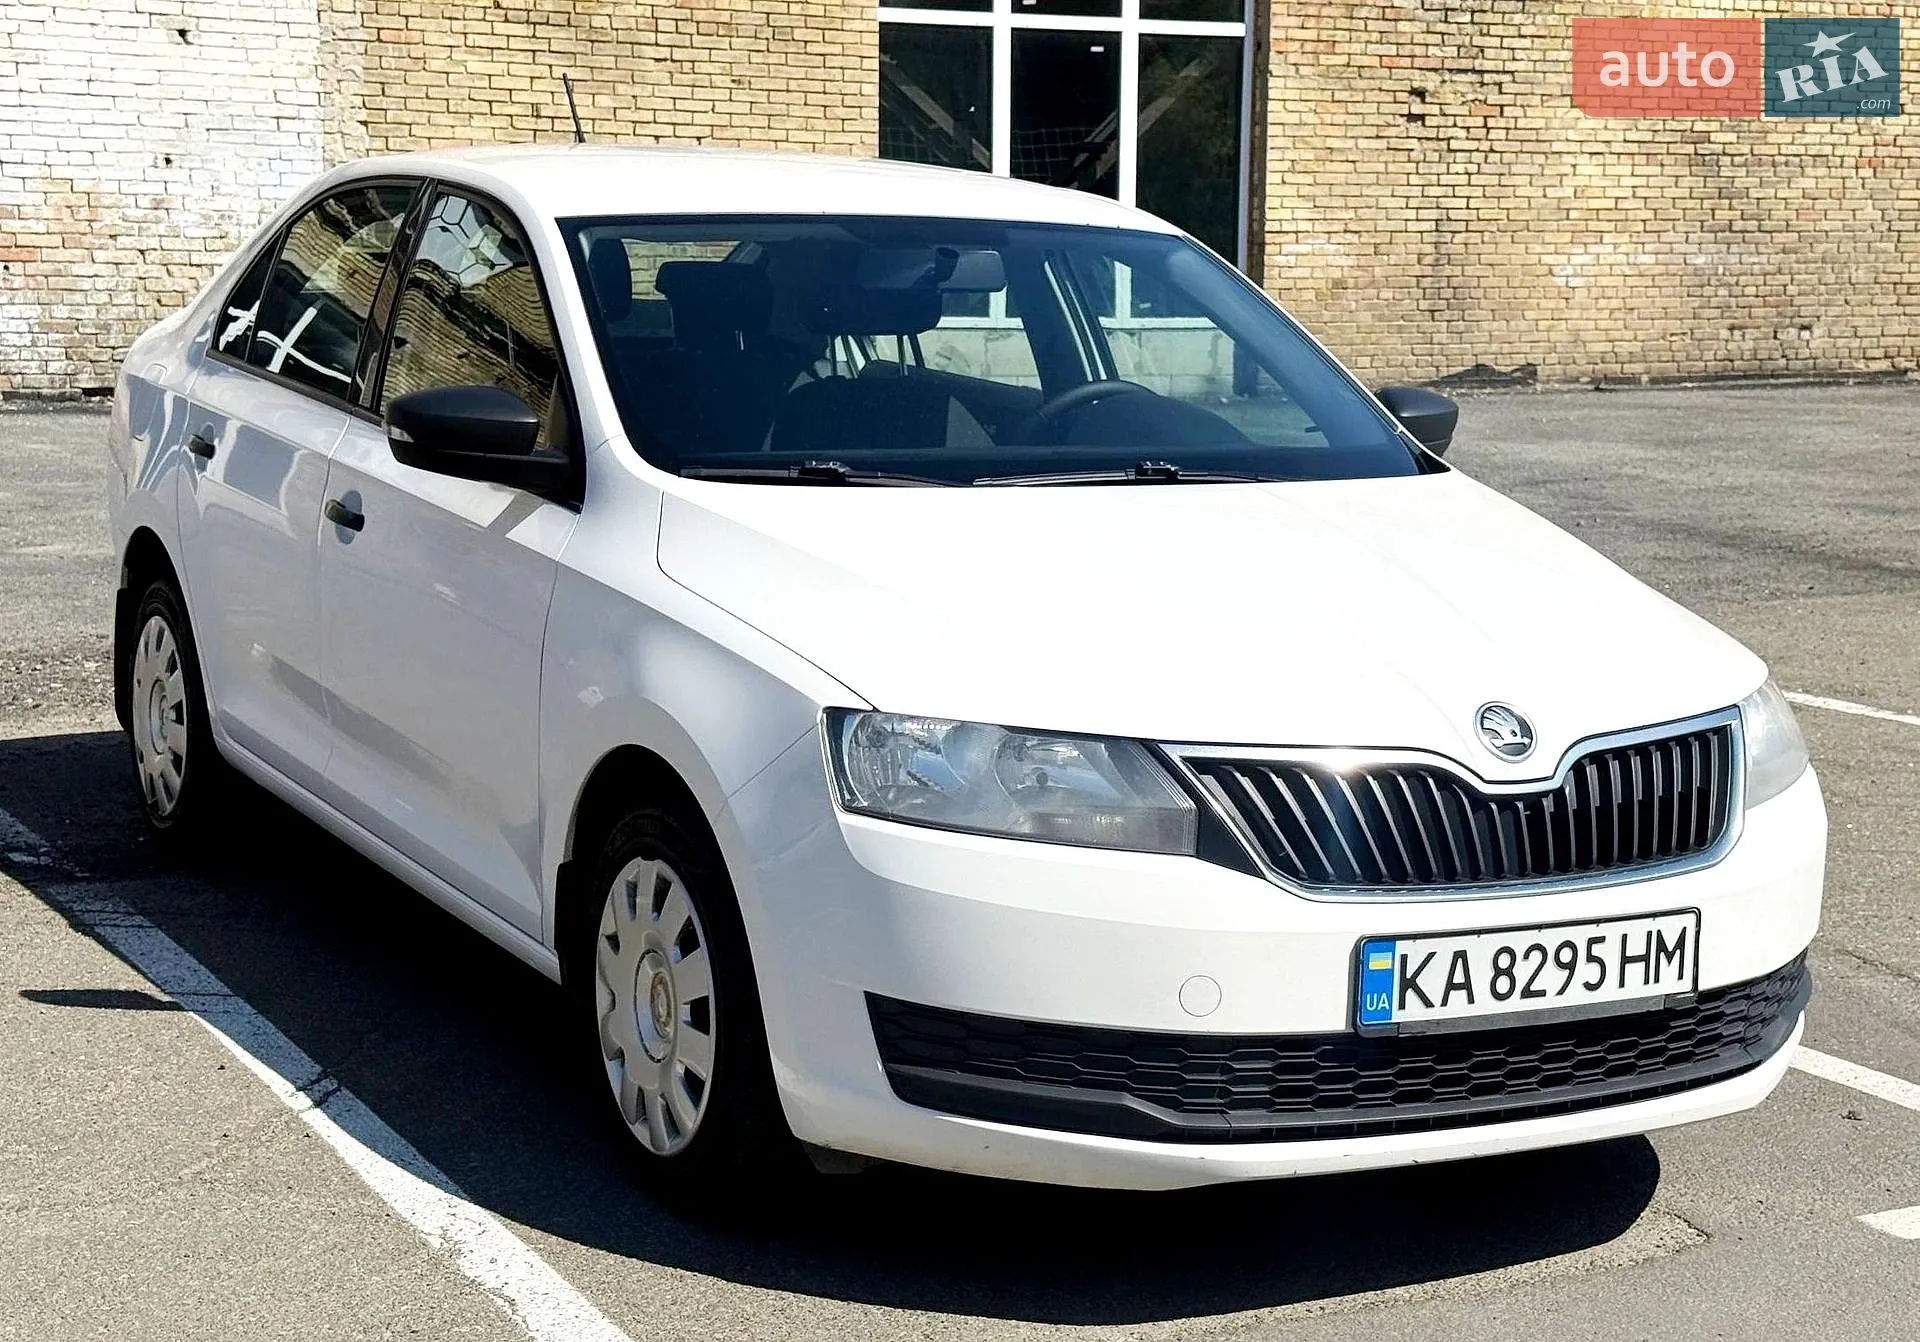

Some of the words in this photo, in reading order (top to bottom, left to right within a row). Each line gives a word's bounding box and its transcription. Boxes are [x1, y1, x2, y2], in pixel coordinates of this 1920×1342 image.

[1398, 949, 1475, 1011] KA
[1490, 936, 1606, 1002] 8295
[1618, 926, 1687, 989] HM
[1366, 992, 1390, 1012] UA
